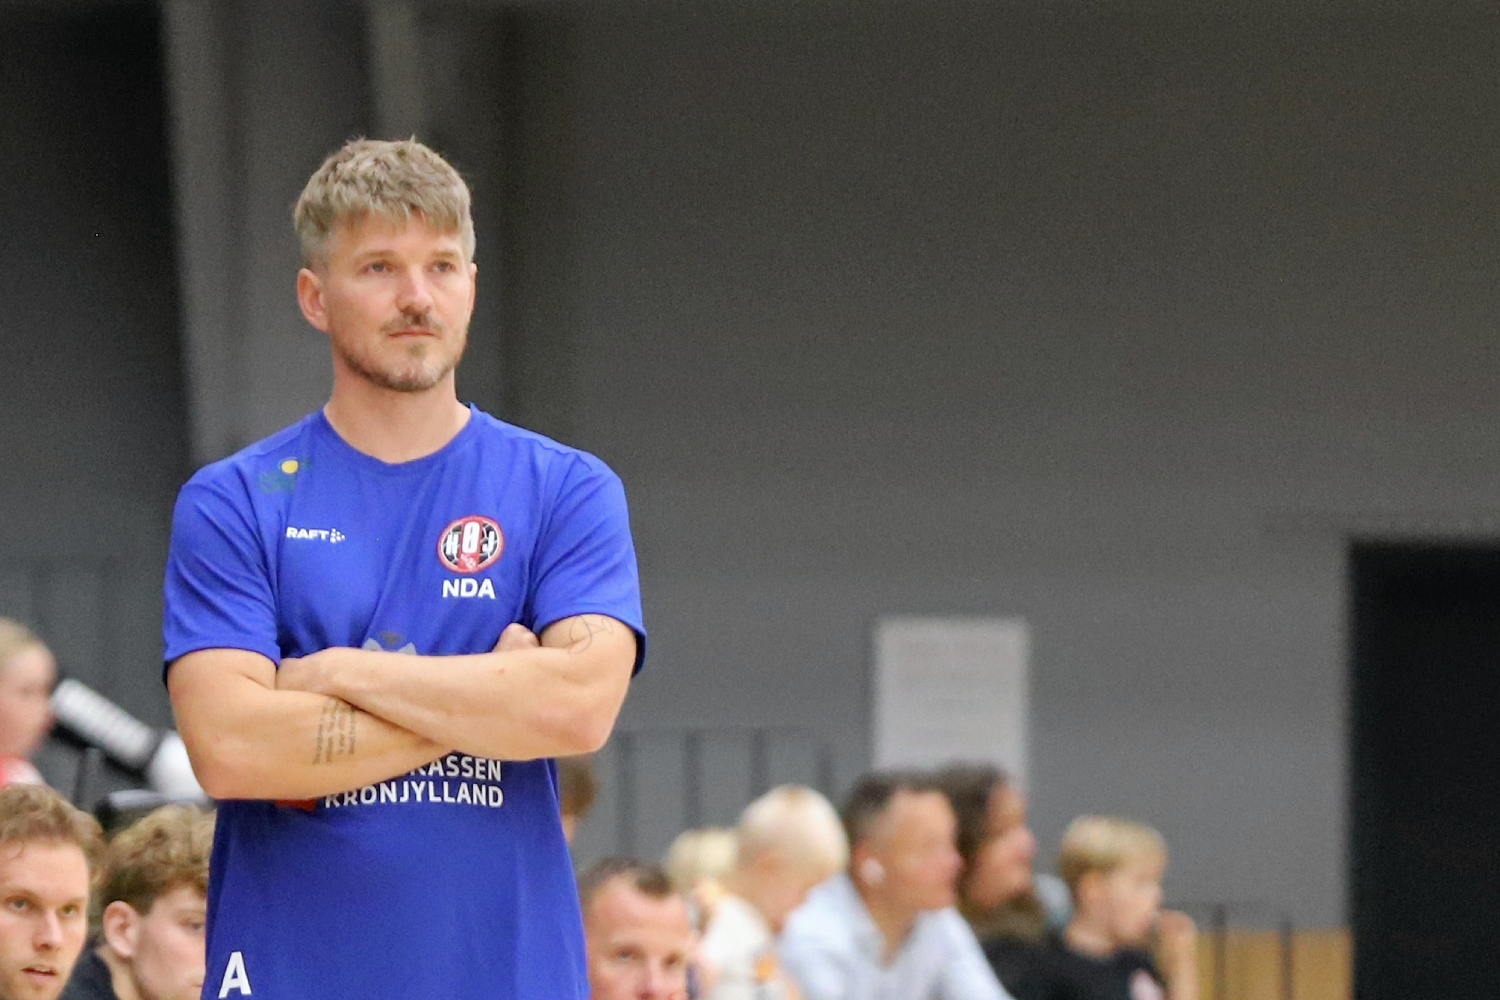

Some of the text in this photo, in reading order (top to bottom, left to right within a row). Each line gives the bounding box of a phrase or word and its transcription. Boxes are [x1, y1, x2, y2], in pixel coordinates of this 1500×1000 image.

[286, 526, 329, 539] RAFT
[442, 577, 497, 599] NDA
[410, 755, 502, 782] ASSEN
[325, 780, 504, 808] KRONJYLLAND
[218, 950, 253, 999] A
